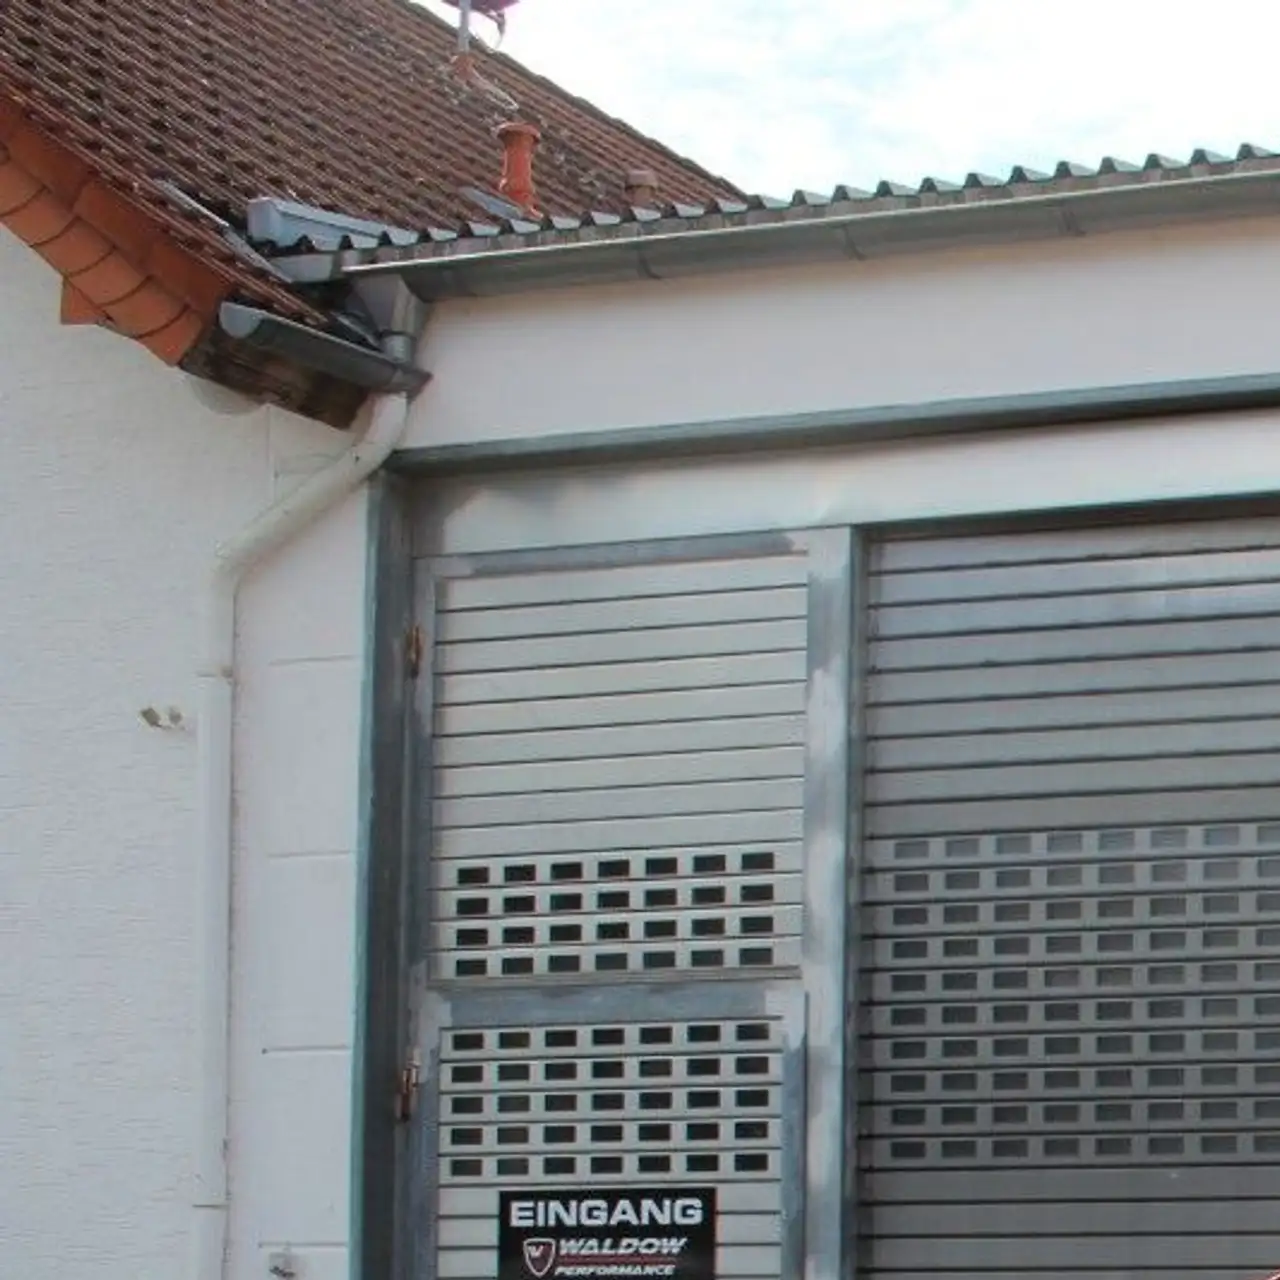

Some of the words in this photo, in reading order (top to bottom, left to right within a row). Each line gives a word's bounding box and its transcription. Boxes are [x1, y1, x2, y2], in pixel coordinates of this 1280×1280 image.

[510, 1198, 703, 1227] EINGANG
[559, 1238, 688, 1255] WALDOW
[555, 1265, 676, 1277] PERFORMANCE
